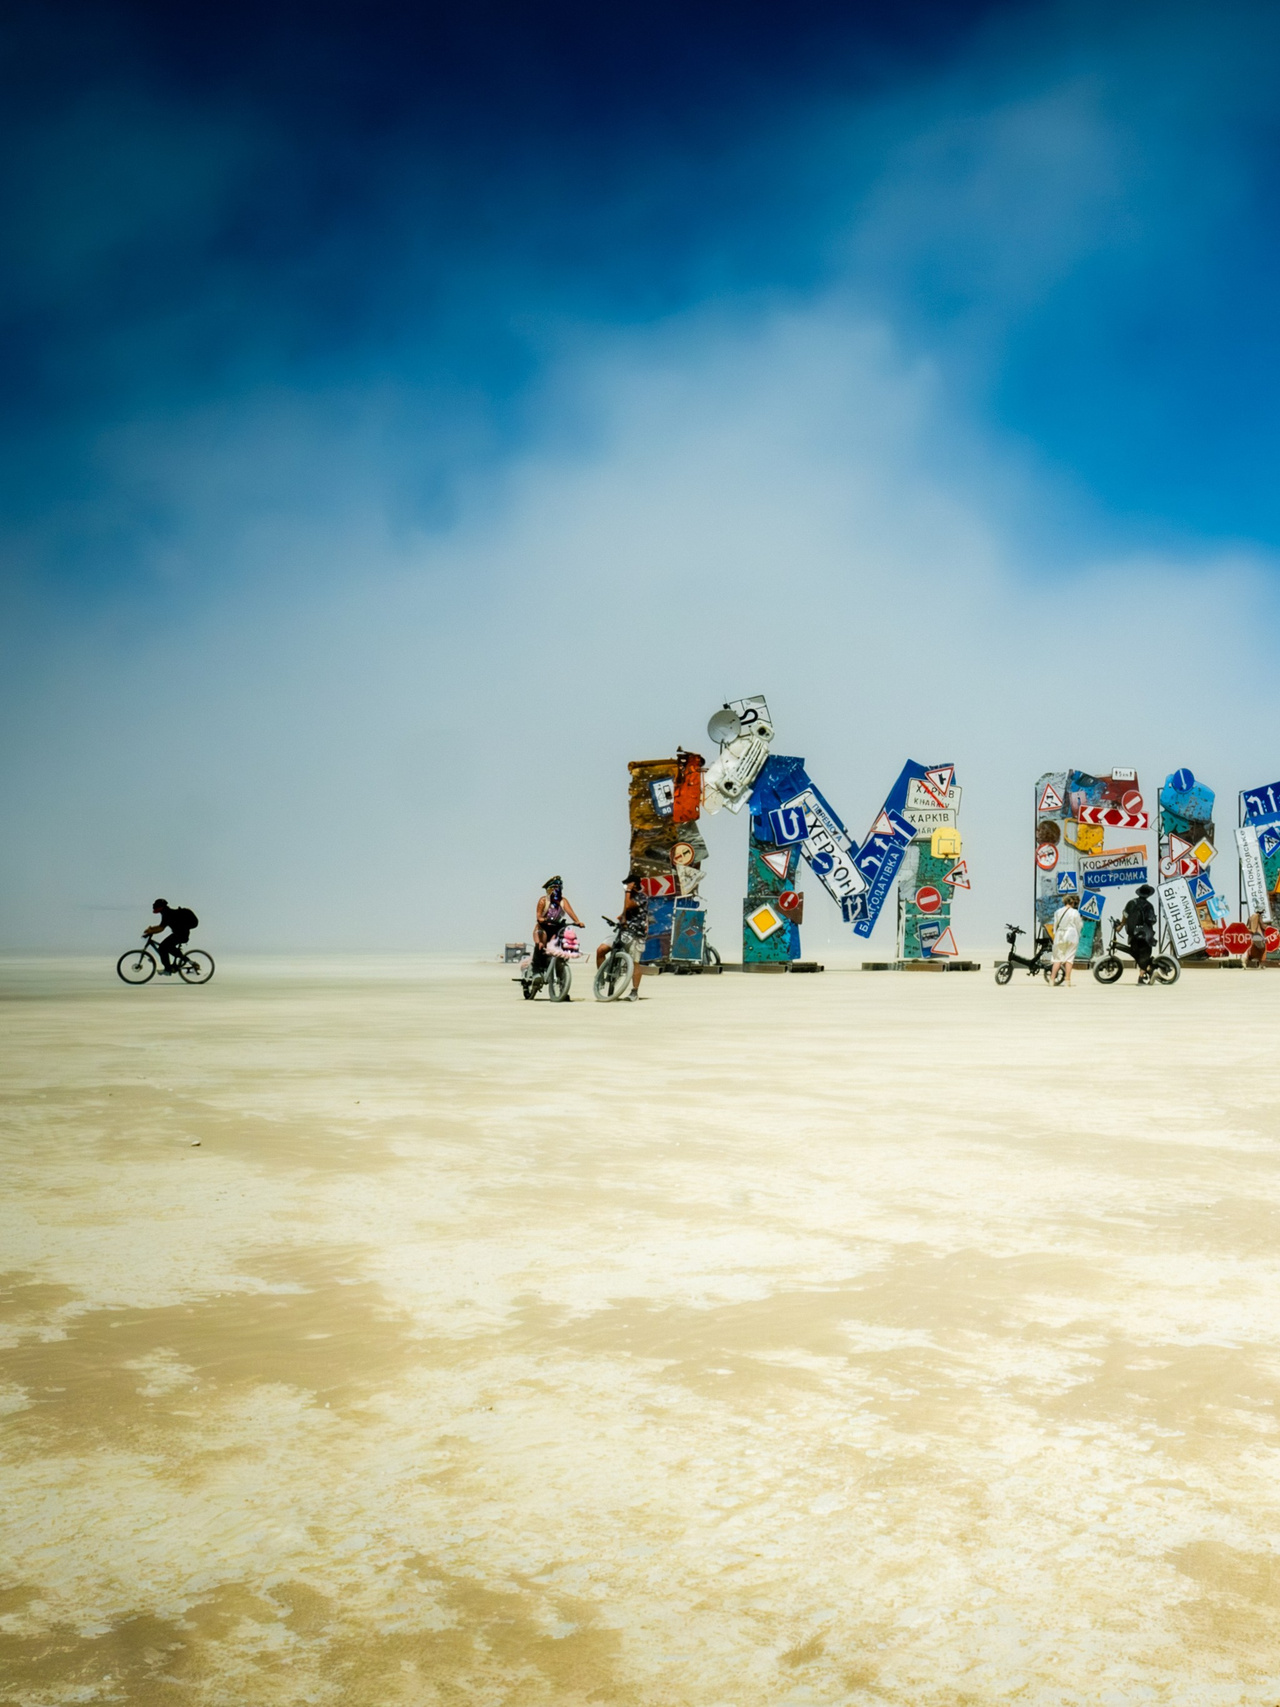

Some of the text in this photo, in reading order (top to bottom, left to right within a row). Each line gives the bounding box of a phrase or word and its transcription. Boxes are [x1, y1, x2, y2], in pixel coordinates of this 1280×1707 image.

[916, 784, 955, 799] ХАРКВ
[914, 798, 950, 809] KHARKV
[910, 813, 949, 823] ХАРКІВ
[1083, 856, 1139, 871] КОСТРОМКА
[1087, 871, 1145, 884] КОСТРОМКА
[1164, 887, 1189, 949] ЧЕРНІГІВ
[1225, 933, 1251, 944] STOP
[1264, 930, 1279, 944] TOP
